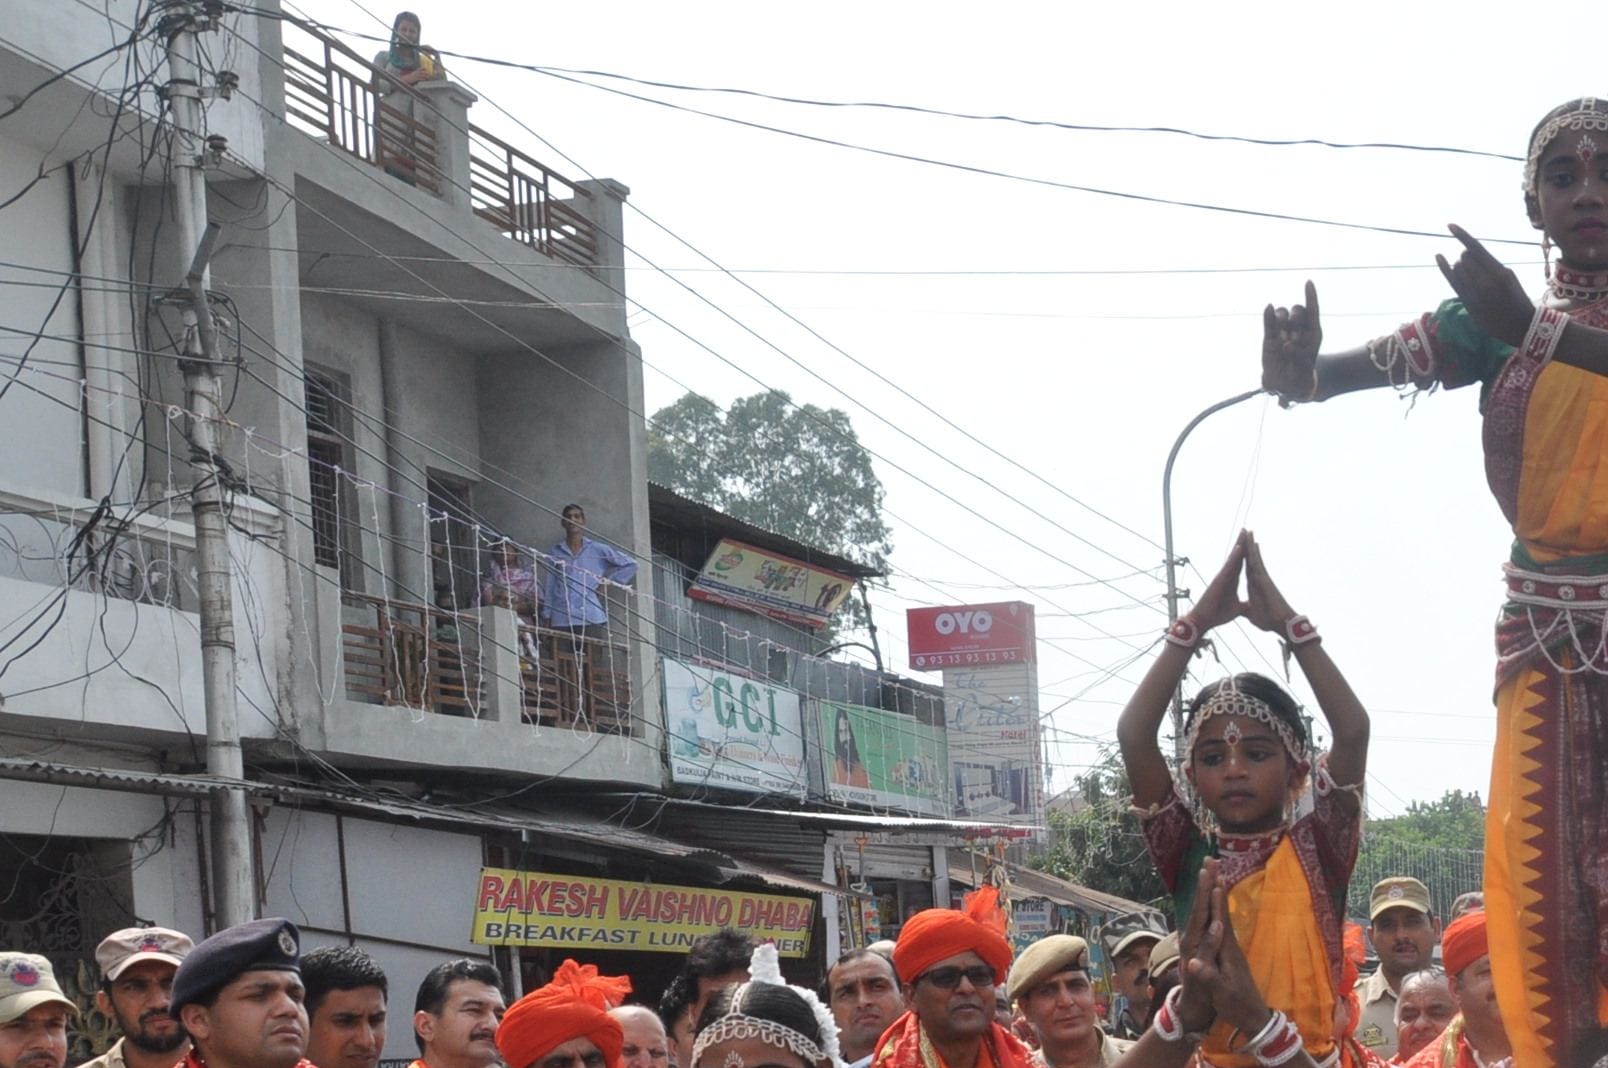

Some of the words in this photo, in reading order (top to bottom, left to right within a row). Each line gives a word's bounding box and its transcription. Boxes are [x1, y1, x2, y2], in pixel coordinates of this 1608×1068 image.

[935, 610, 992, 635] OYO
[929, 655, 943, 665] 93
[949, 654, 960, 664] 13
[966, 653, 979, 663] 93
[986, 652, 997, 661] 13
[1002, 651, 1016, 660] 93
[713, 676, 781, 736] GCI
[479, 875, 610, 919] RAKESH
[618, 886, 733, 927] VAISHNO
[737, 898, 813, 931] DHABA
[485, 922, 641, 944] BREAKFAST
